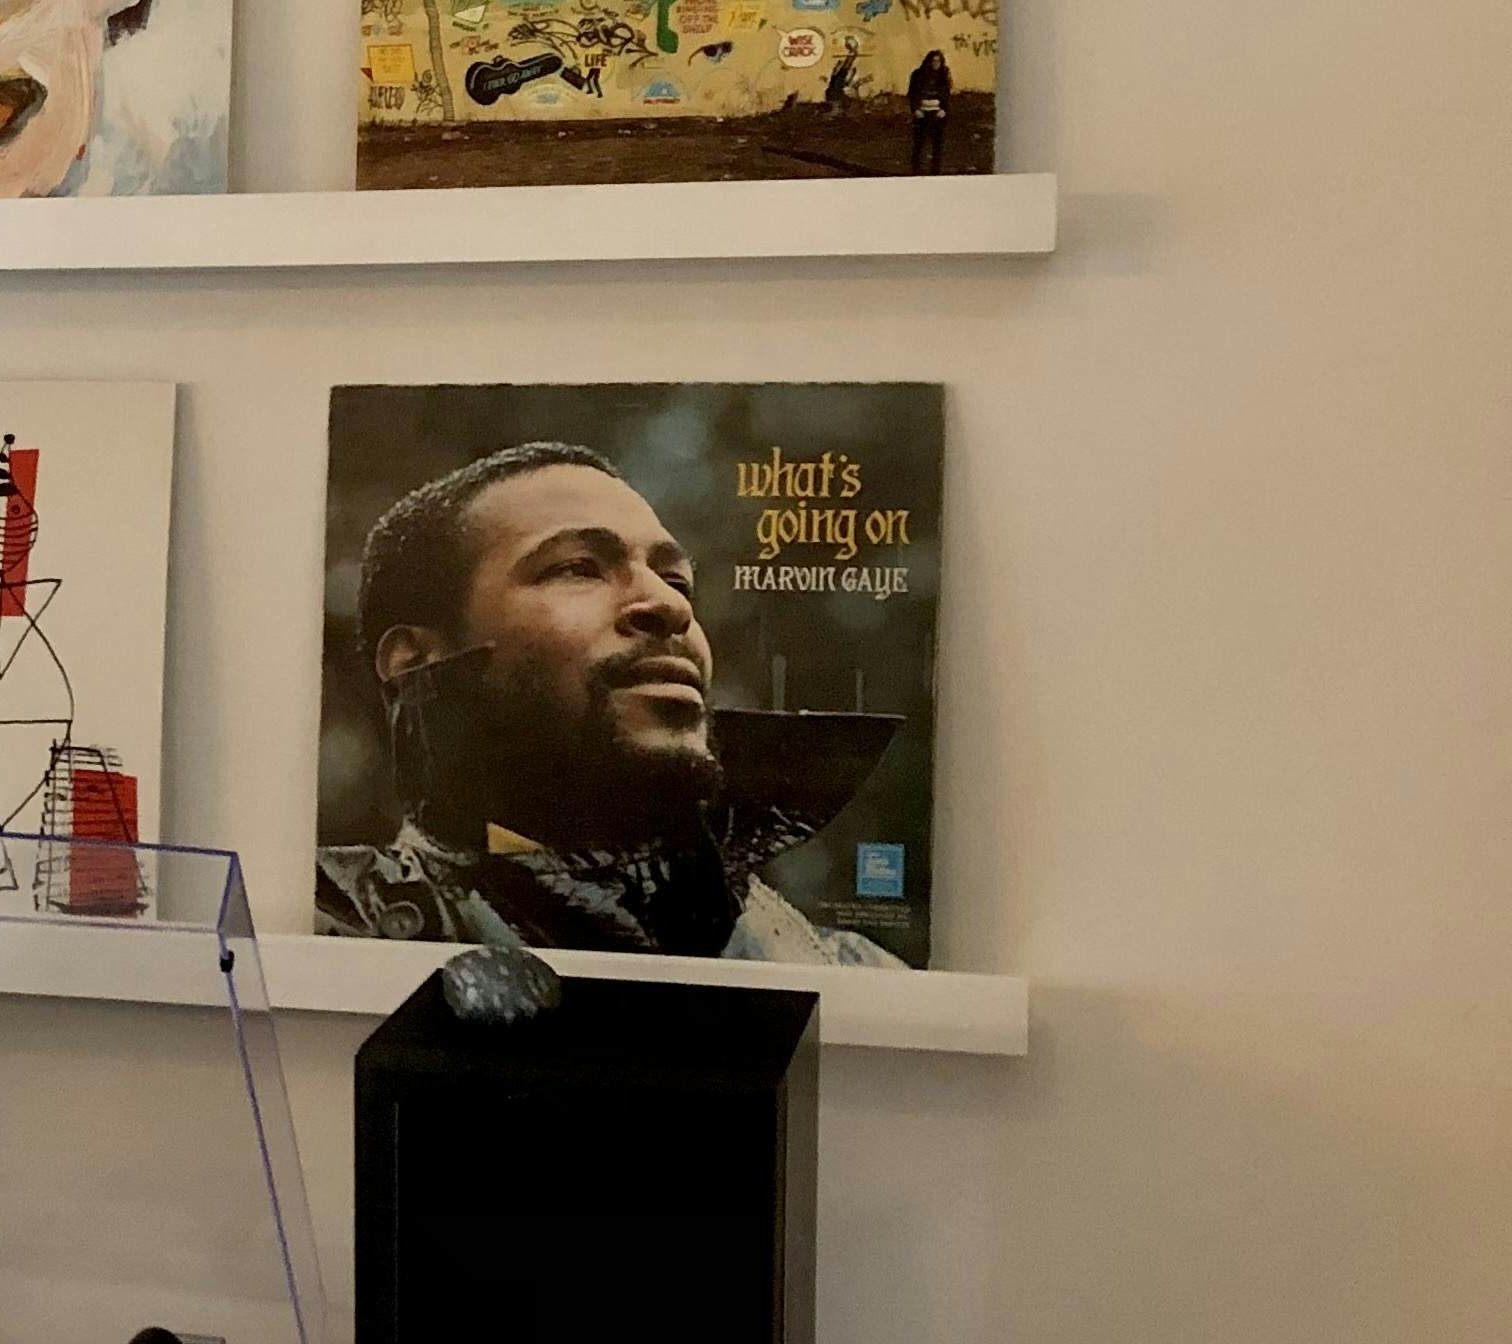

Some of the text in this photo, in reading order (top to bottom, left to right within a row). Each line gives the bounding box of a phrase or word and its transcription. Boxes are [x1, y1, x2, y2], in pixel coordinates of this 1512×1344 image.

[584, 53, 608, 68] LIFE
[737, 446, 862, 497] what's
[756, 500, 910, 560] going on
[734, 565, 909, 600] MARVIN GAYE
